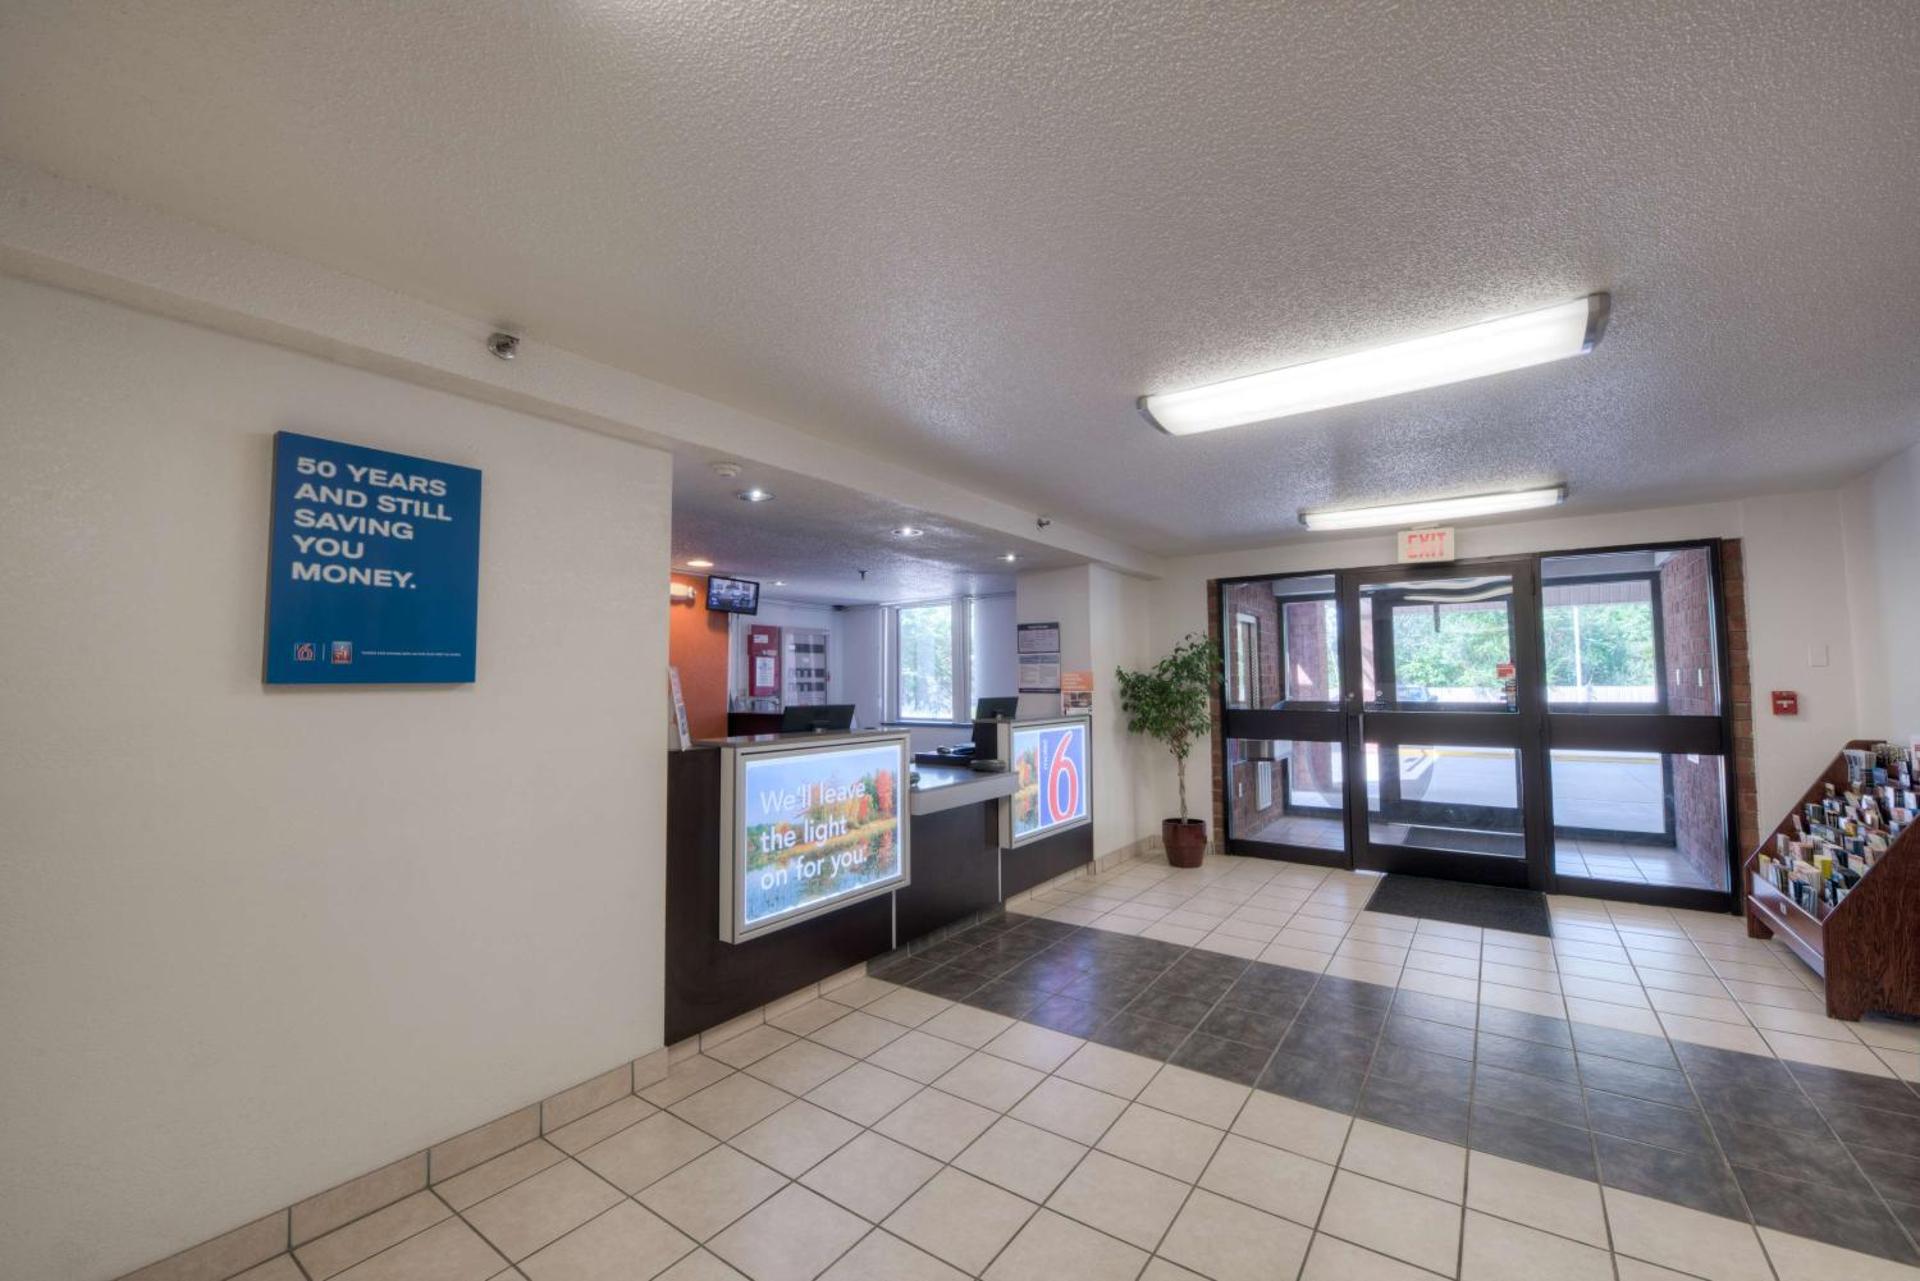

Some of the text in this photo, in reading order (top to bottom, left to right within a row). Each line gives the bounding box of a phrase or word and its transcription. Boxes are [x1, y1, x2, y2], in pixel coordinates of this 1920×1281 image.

[297, 456, 447, 497] 50 YEARS
[294, 482, 452, 521] AND STILL
[293, 508, 414, 540] SAVING
[292, 534, 365, 559] YOU
[1407, 532, 1444, 558] EXIT
[291, 561, 416, 589] MONEY.
[1047, 730, 1079, 823] 6
[760, 781, 866, 815] We'll leave
[761, 814, 848, 853] the light
[761, 847, 867, 890] on for you.
